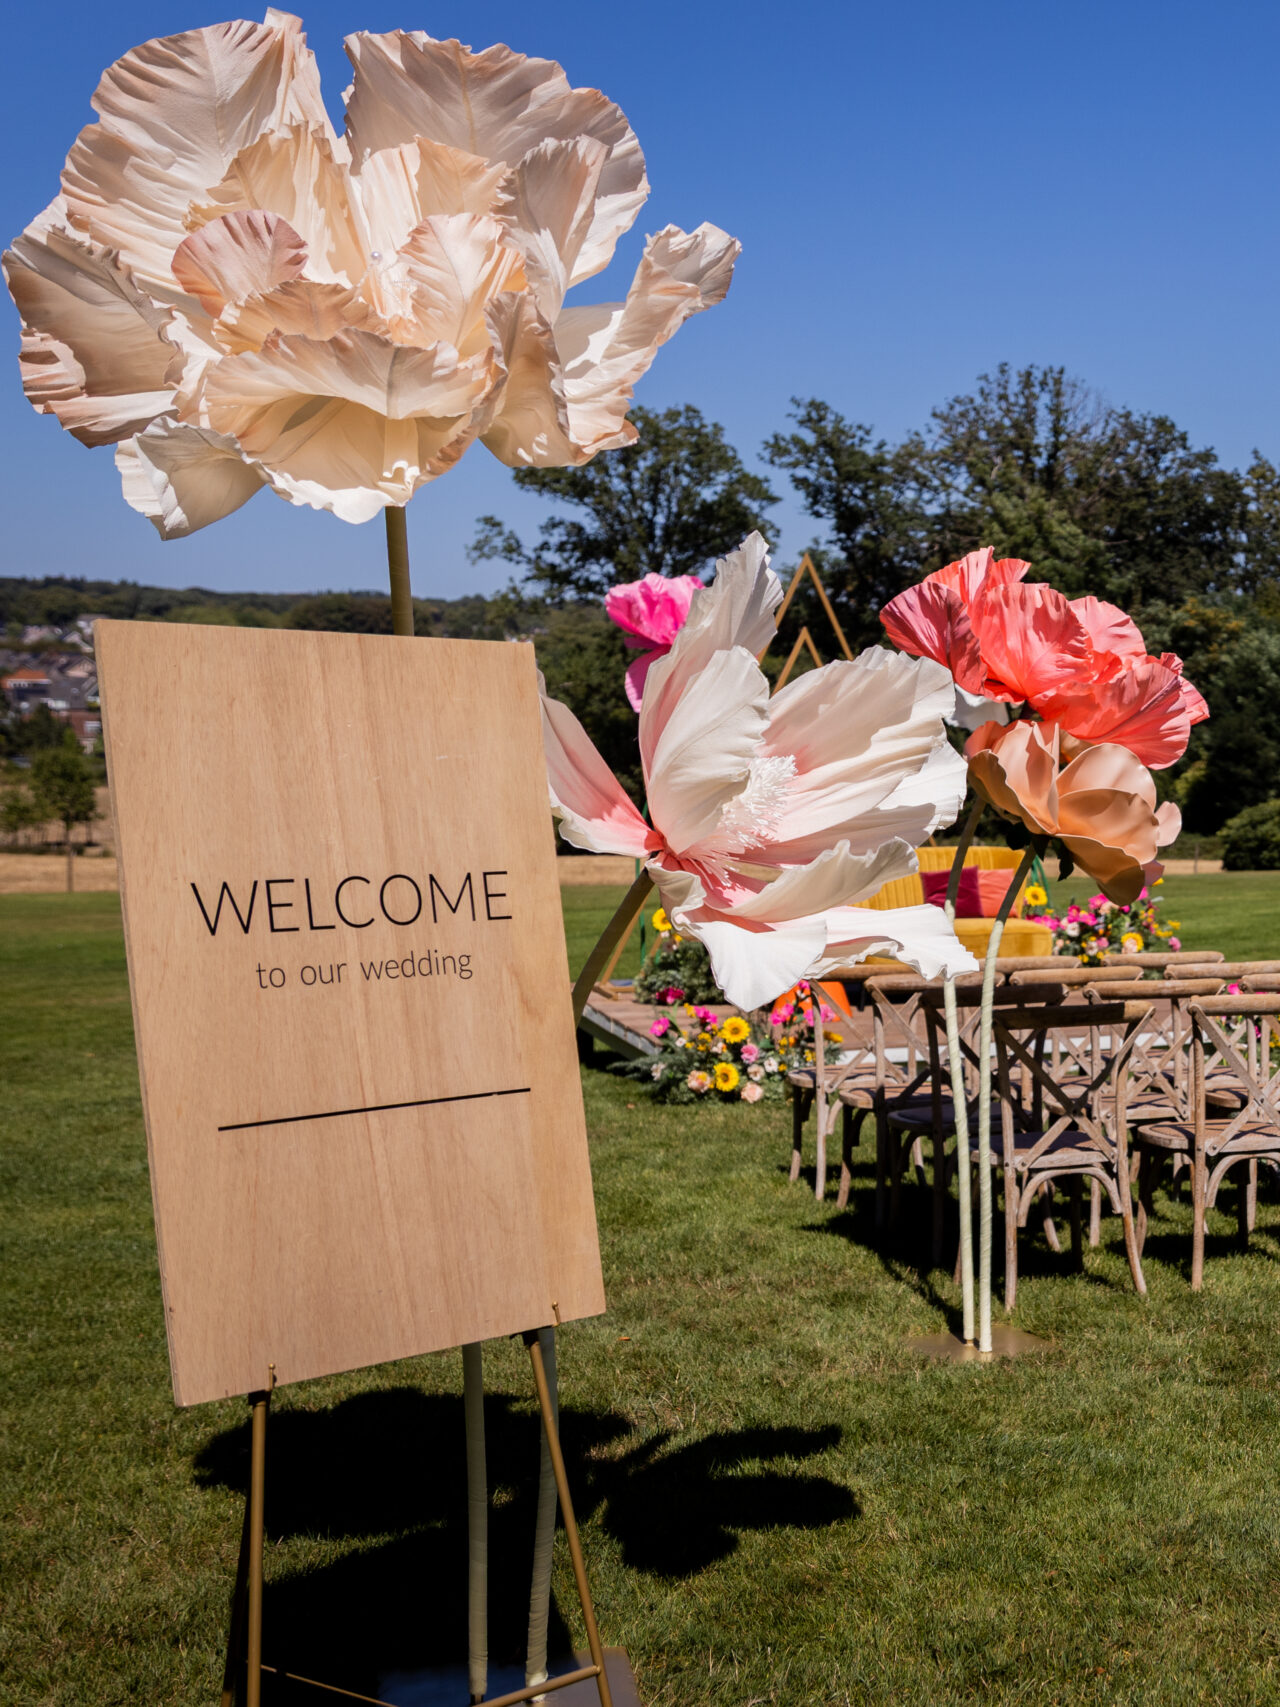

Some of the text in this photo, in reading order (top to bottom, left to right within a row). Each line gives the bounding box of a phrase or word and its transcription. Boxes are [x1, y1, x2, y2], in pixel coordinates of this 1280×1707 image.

[190, 870, 513, 937] WELCOME
[255, 949, 473, 989] to our wedding
